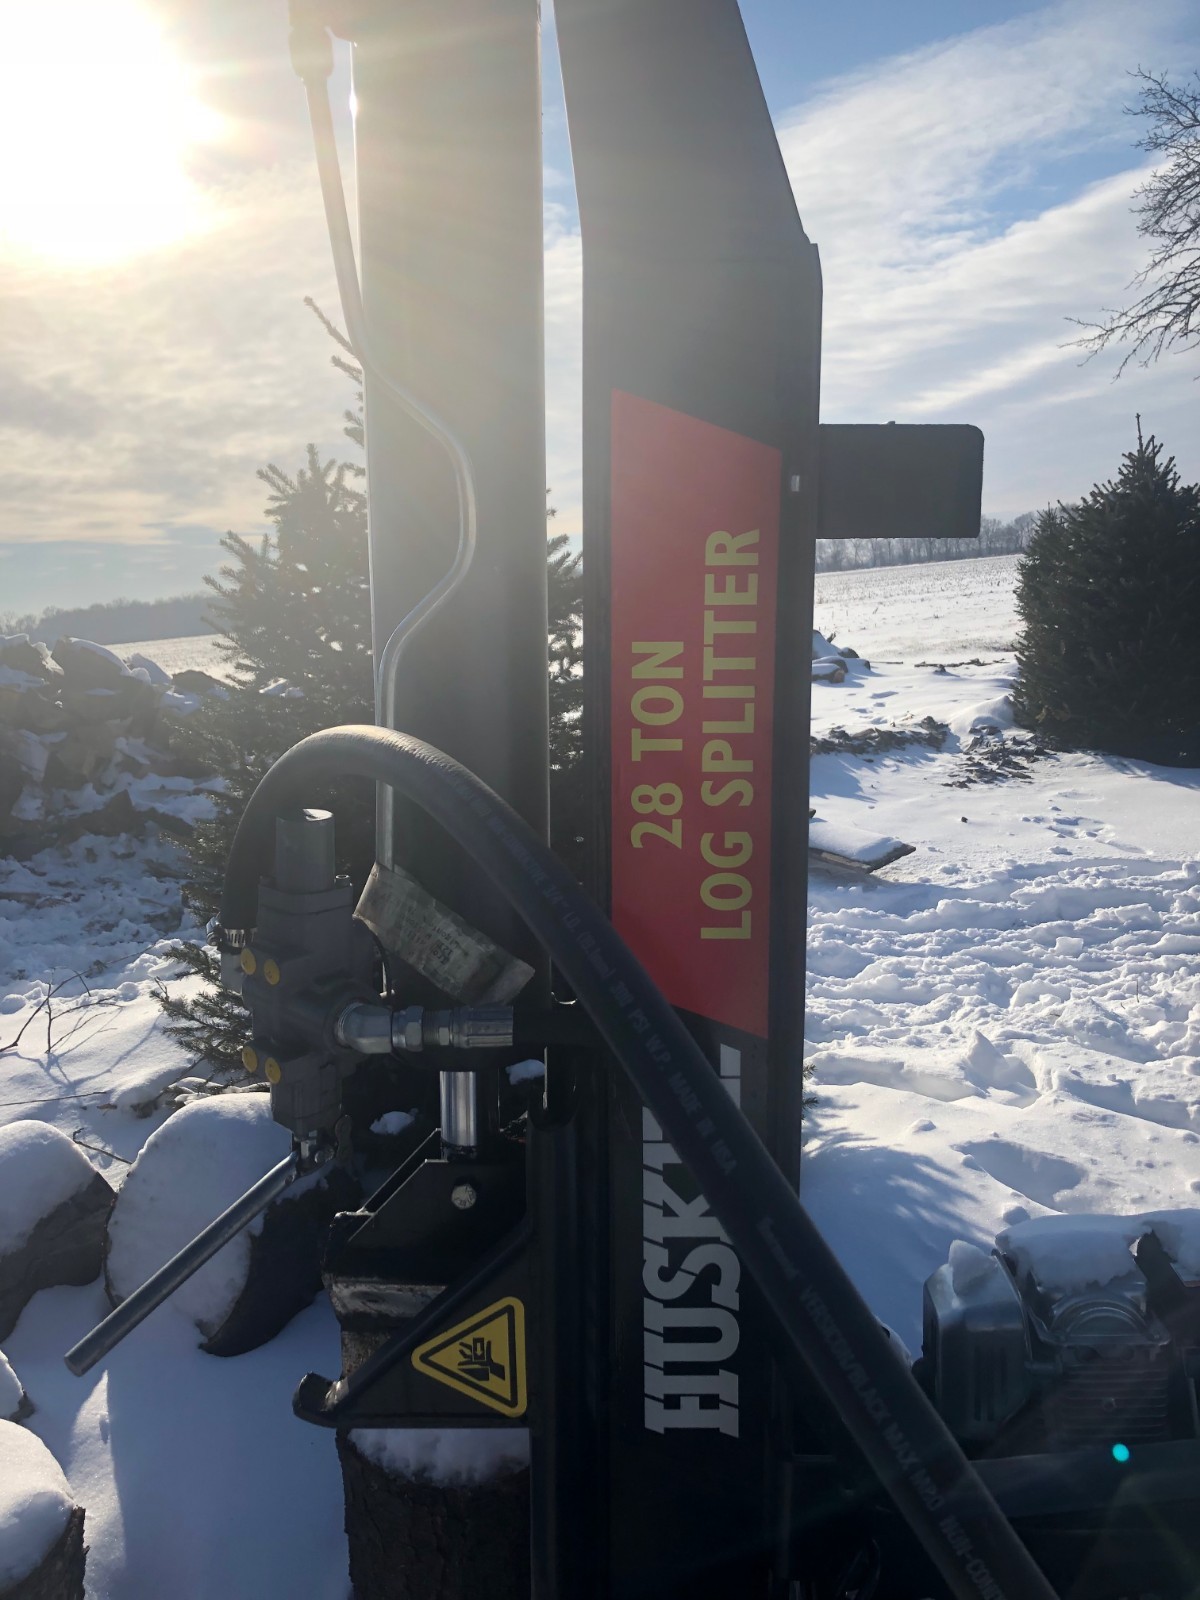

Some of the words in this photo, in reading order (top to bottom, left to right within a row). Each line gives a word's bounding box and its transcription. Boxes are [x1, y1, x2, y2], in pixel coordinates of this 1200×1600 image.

[631, 641, 684, 760] TON
[701, 529, 760, 808] SPLITTER
[631, 782, 683, 851] 28
[700, 831, 753, 941] LOG
[665, 1070, 703, 1116] MADE
[707, 1138, 739, 1176] USA
[643, 1043, 741, 1439] HUSK
